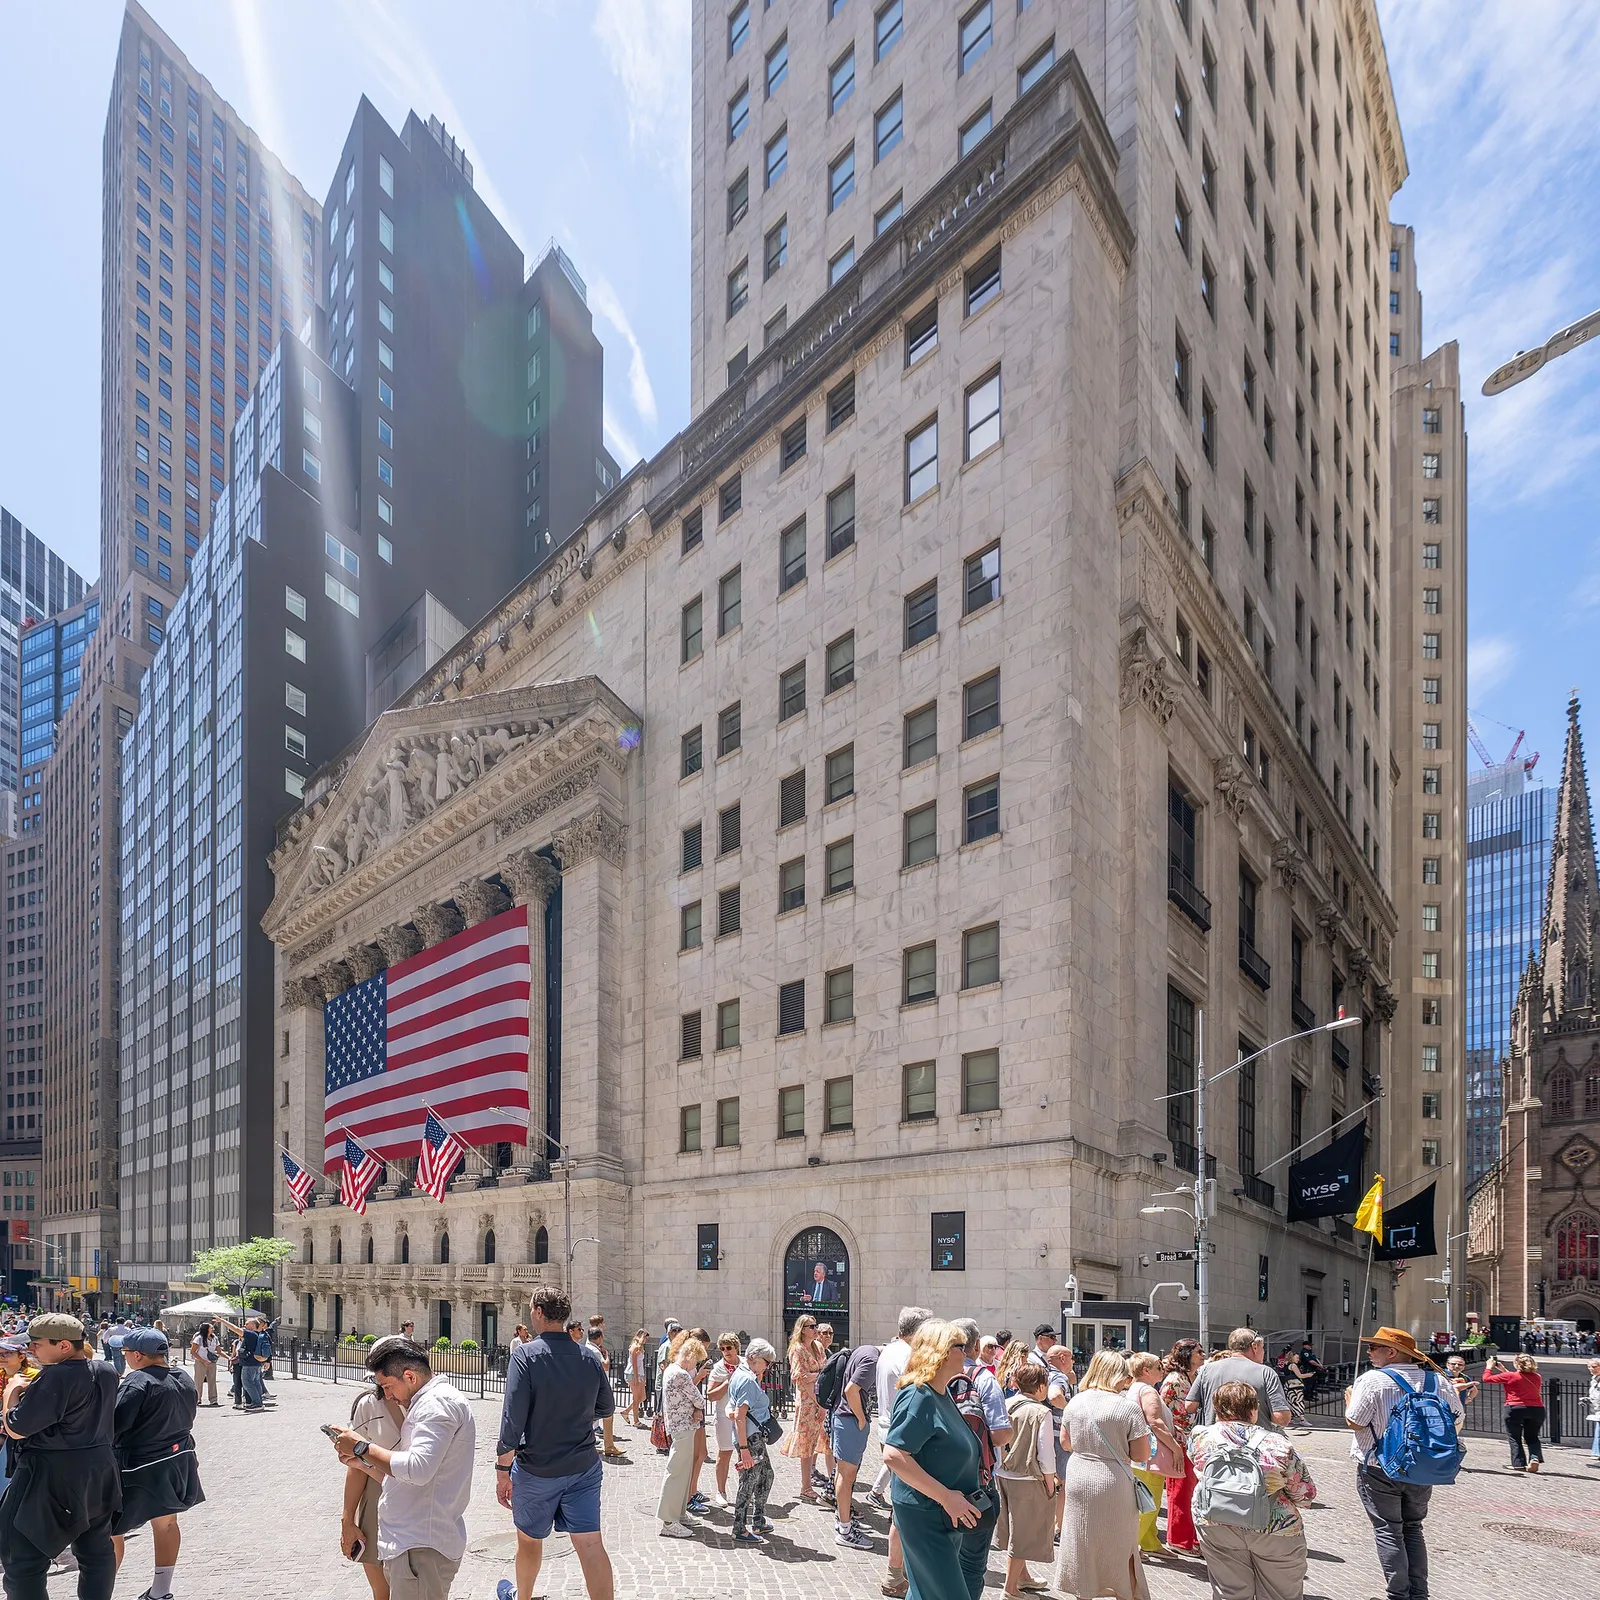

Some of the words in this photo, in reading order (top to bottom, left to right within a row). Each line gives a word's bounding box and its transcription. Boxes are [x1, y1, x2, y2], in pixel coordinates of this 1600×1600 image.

[353, 910, 368, 927] NEW
[371, 899, 391, 916] YORK
[394, 881, 419, 901] STOCK
[423, 847, 470, 882] EXCHANGE
[1160, 1252, 1177, 1261] Broad
